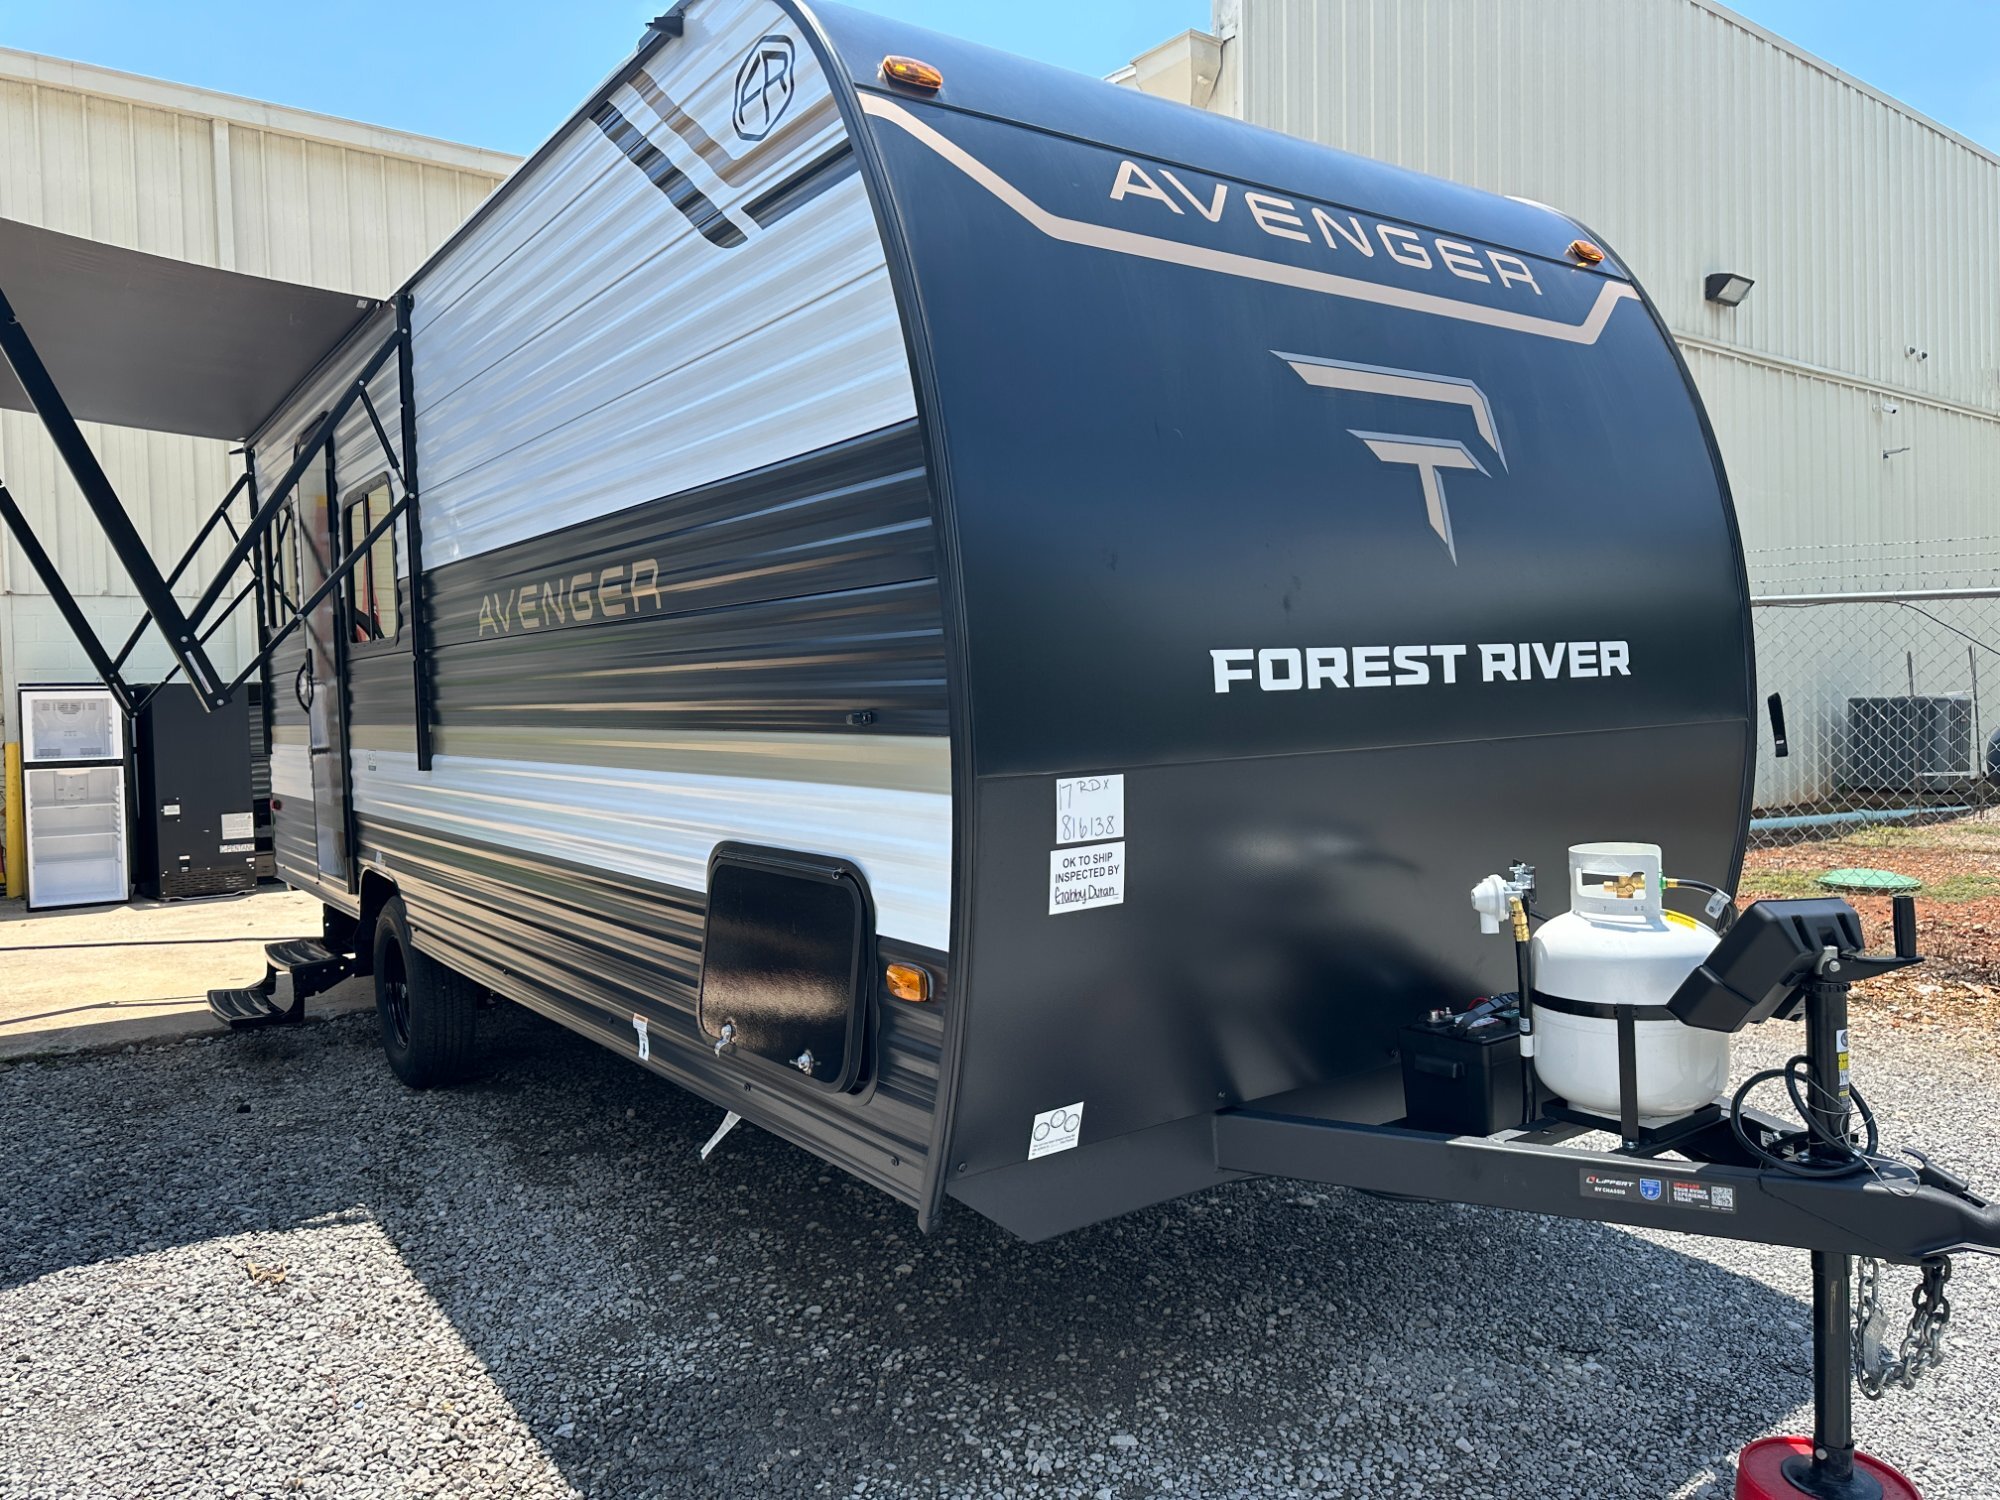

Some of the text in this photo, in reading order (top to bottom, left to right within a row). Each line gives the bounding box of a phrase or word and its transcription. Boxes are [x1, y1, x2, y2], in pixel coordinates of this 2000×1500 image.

[1108, 159, 1543, 296] AVENGER
[478, 557, 662, 637] AVENGER
[1208, 640, 1631, 693] FOREST RIVER
[1061, 815, 1115, 841] 816138
[1055, 864, 1120, 884] INSPECTED BY
[1062, 852, 1113, 868] OK TO SHIP
